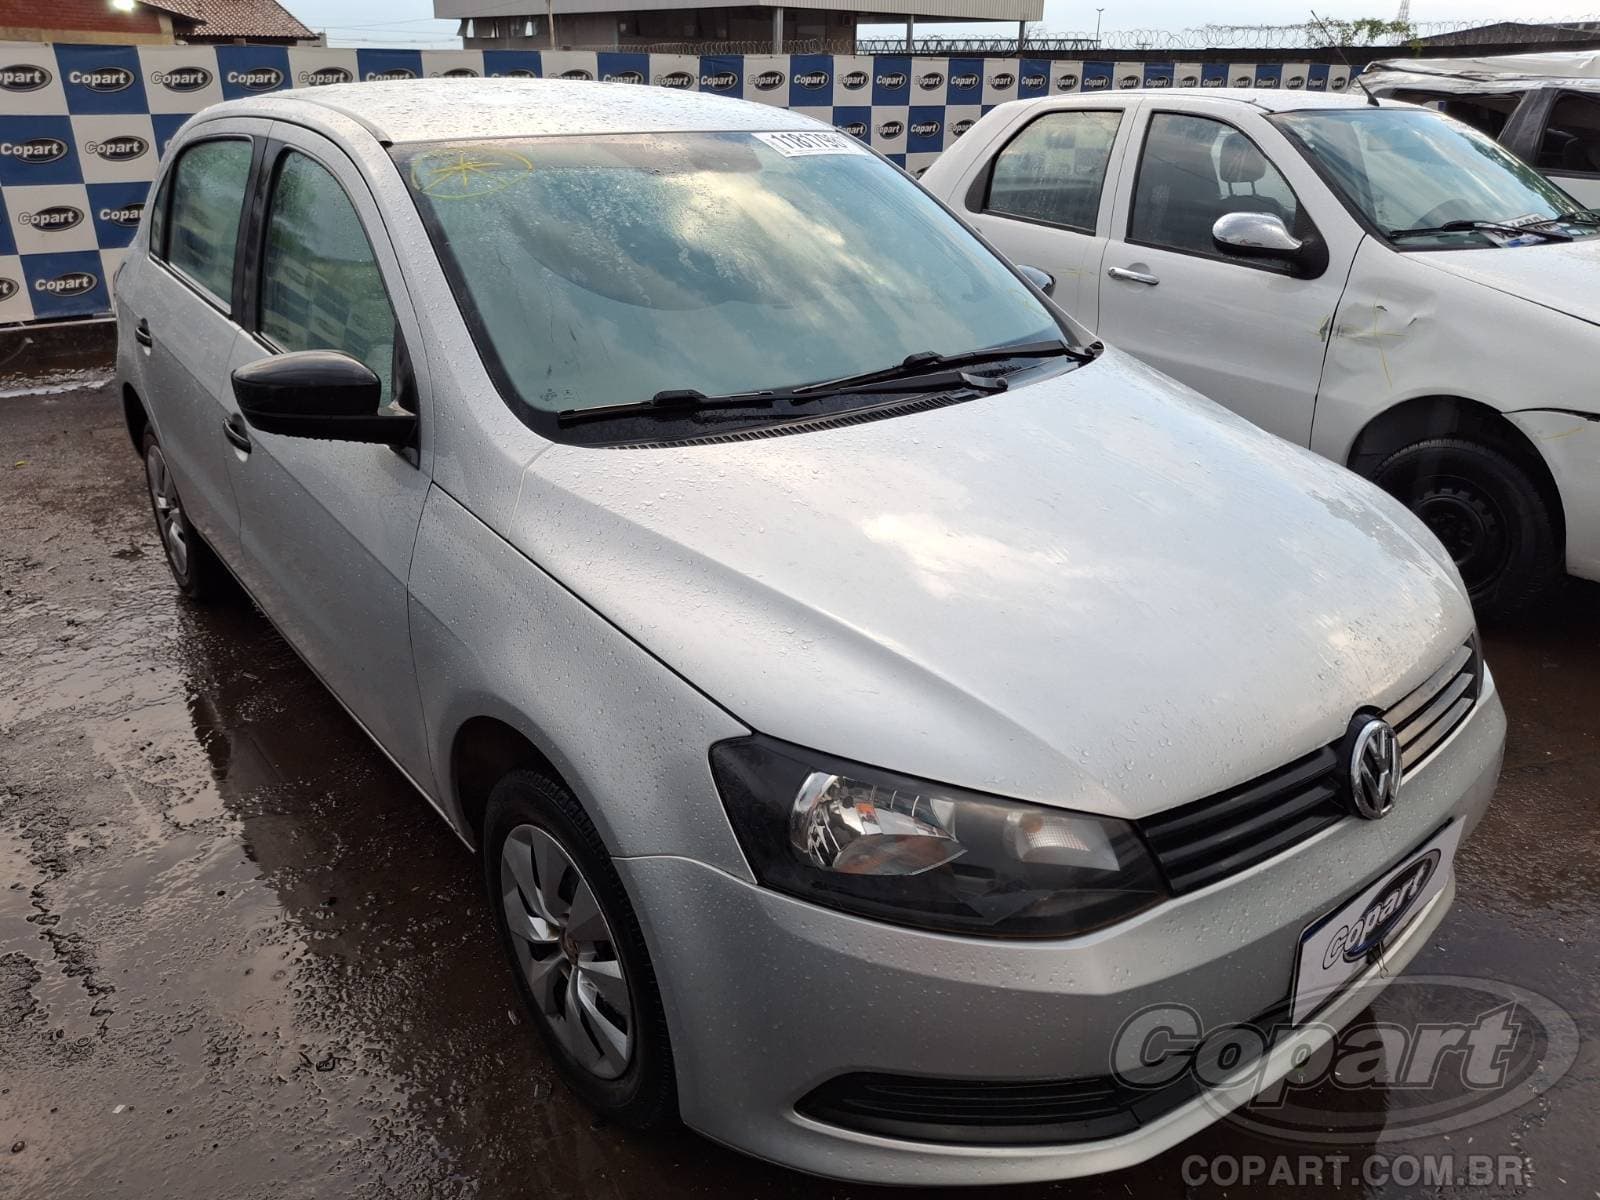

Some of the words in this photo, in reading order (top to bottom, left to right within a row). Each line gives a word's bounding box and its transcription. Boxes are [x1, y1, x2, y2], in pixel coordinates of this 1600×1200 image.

[70, 72, 126, 87] Copart
[151, 71, 204, 85] Copart
[228, 71, 277, 85] Copart
[299, 71, 345, 84] Copart
[654, 74, 689, 85] Copart
[701, 75, 733, 87] Copart
[747, 73, 780, 86] Copart
[793, 74, 825, 86] Copart
[837, 74, 864, 85] Copart
[876, 75, 903, 86] Copart
[914, 75, 942, 86] Copart
[951, 76, 976, 86] Copart
[987, 76, 1011, 87] Copart
[1021, 76, 1044, 86] Copart
[1084, 77, 1106, 87] Copart
[1146, 78, 1168, 88] Copart
[1203, 79, 1222, 88] Copart
[911, 124, 936, 135] Copart
[0, 143, 58, 158] Copart
[85, 141, 140, 155] Copart
[18, 212, 74, 227] Copart
[100, 208, 143, 222] Copar
[35, 277, 89, 292] Copart
[1322, 866, 1428, 970] Copart
